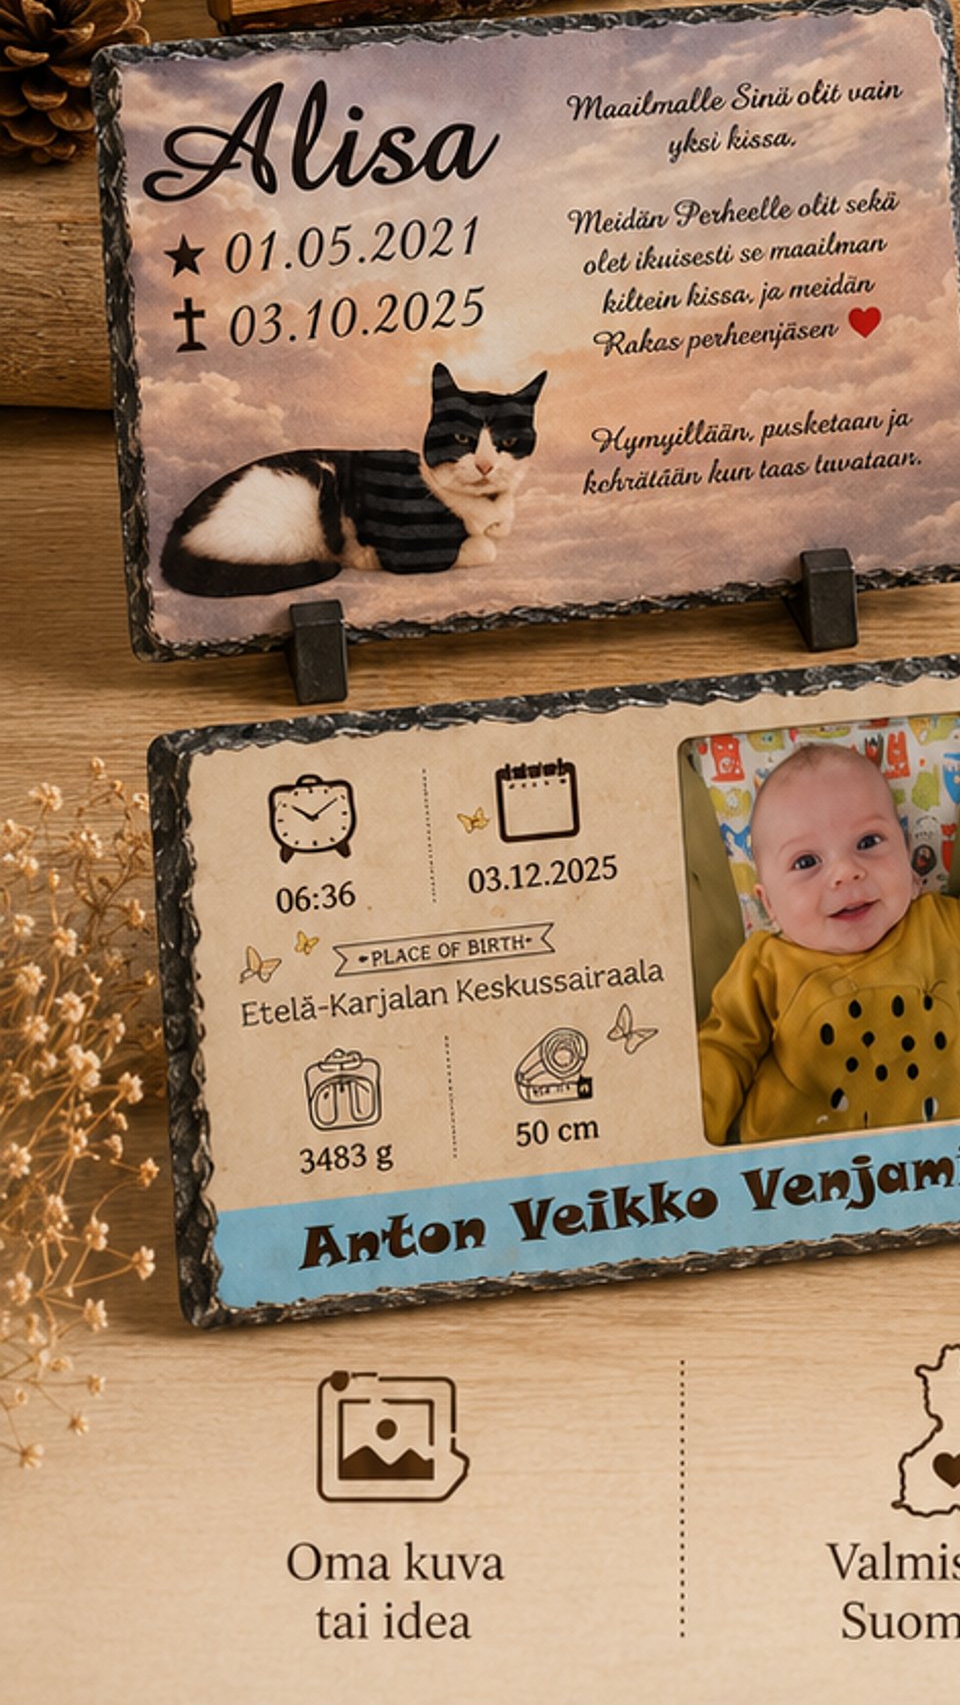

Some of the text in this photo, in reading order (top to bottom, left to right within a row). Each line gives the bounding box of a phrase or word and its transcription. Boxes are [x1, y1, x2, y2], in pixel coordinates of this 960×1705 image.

[567, 79, 903, 121] Maailmalle Sinä olit vain
[142, 80, 500, 202] Alisa
[669, 127, 720, 163] yksi
[568, 188, 900, 234] Meidän Perheelle olit sekä
[226, 216, 478, 273] 01.05.2021
[584, 232, 887, 275] olet ikuisesti se maailman
[603, 287, 681, 313] kiltein
[759, 282, 784, 309] ja
[789, 272, 875, 298] meidän
[230, 287, 484, 346] 03.10.2025
[593, 322, 839, 358] Rakas perheenjäsen
[760, 410, 883, 446] pusketaan
[886, 409, 913, 436] ja
[708, 459, 754, 483] kun
[760, 460, 809, 478] taas
[469, 855, 617, 893] 03.12.2025
[277, 881, 355, 914] 06:36
[438, 942, 461, 958] OF
[240, 958, 664, 1026] Etelä-Karjalan Keskussairaala
[517, 1120, 598, 1147] 50 cm
[300, 1144, 393, 1174] 3483 g
[299, 1214, 485, 1270] Anton
[510, 1181, 718, 1241] Veikko
